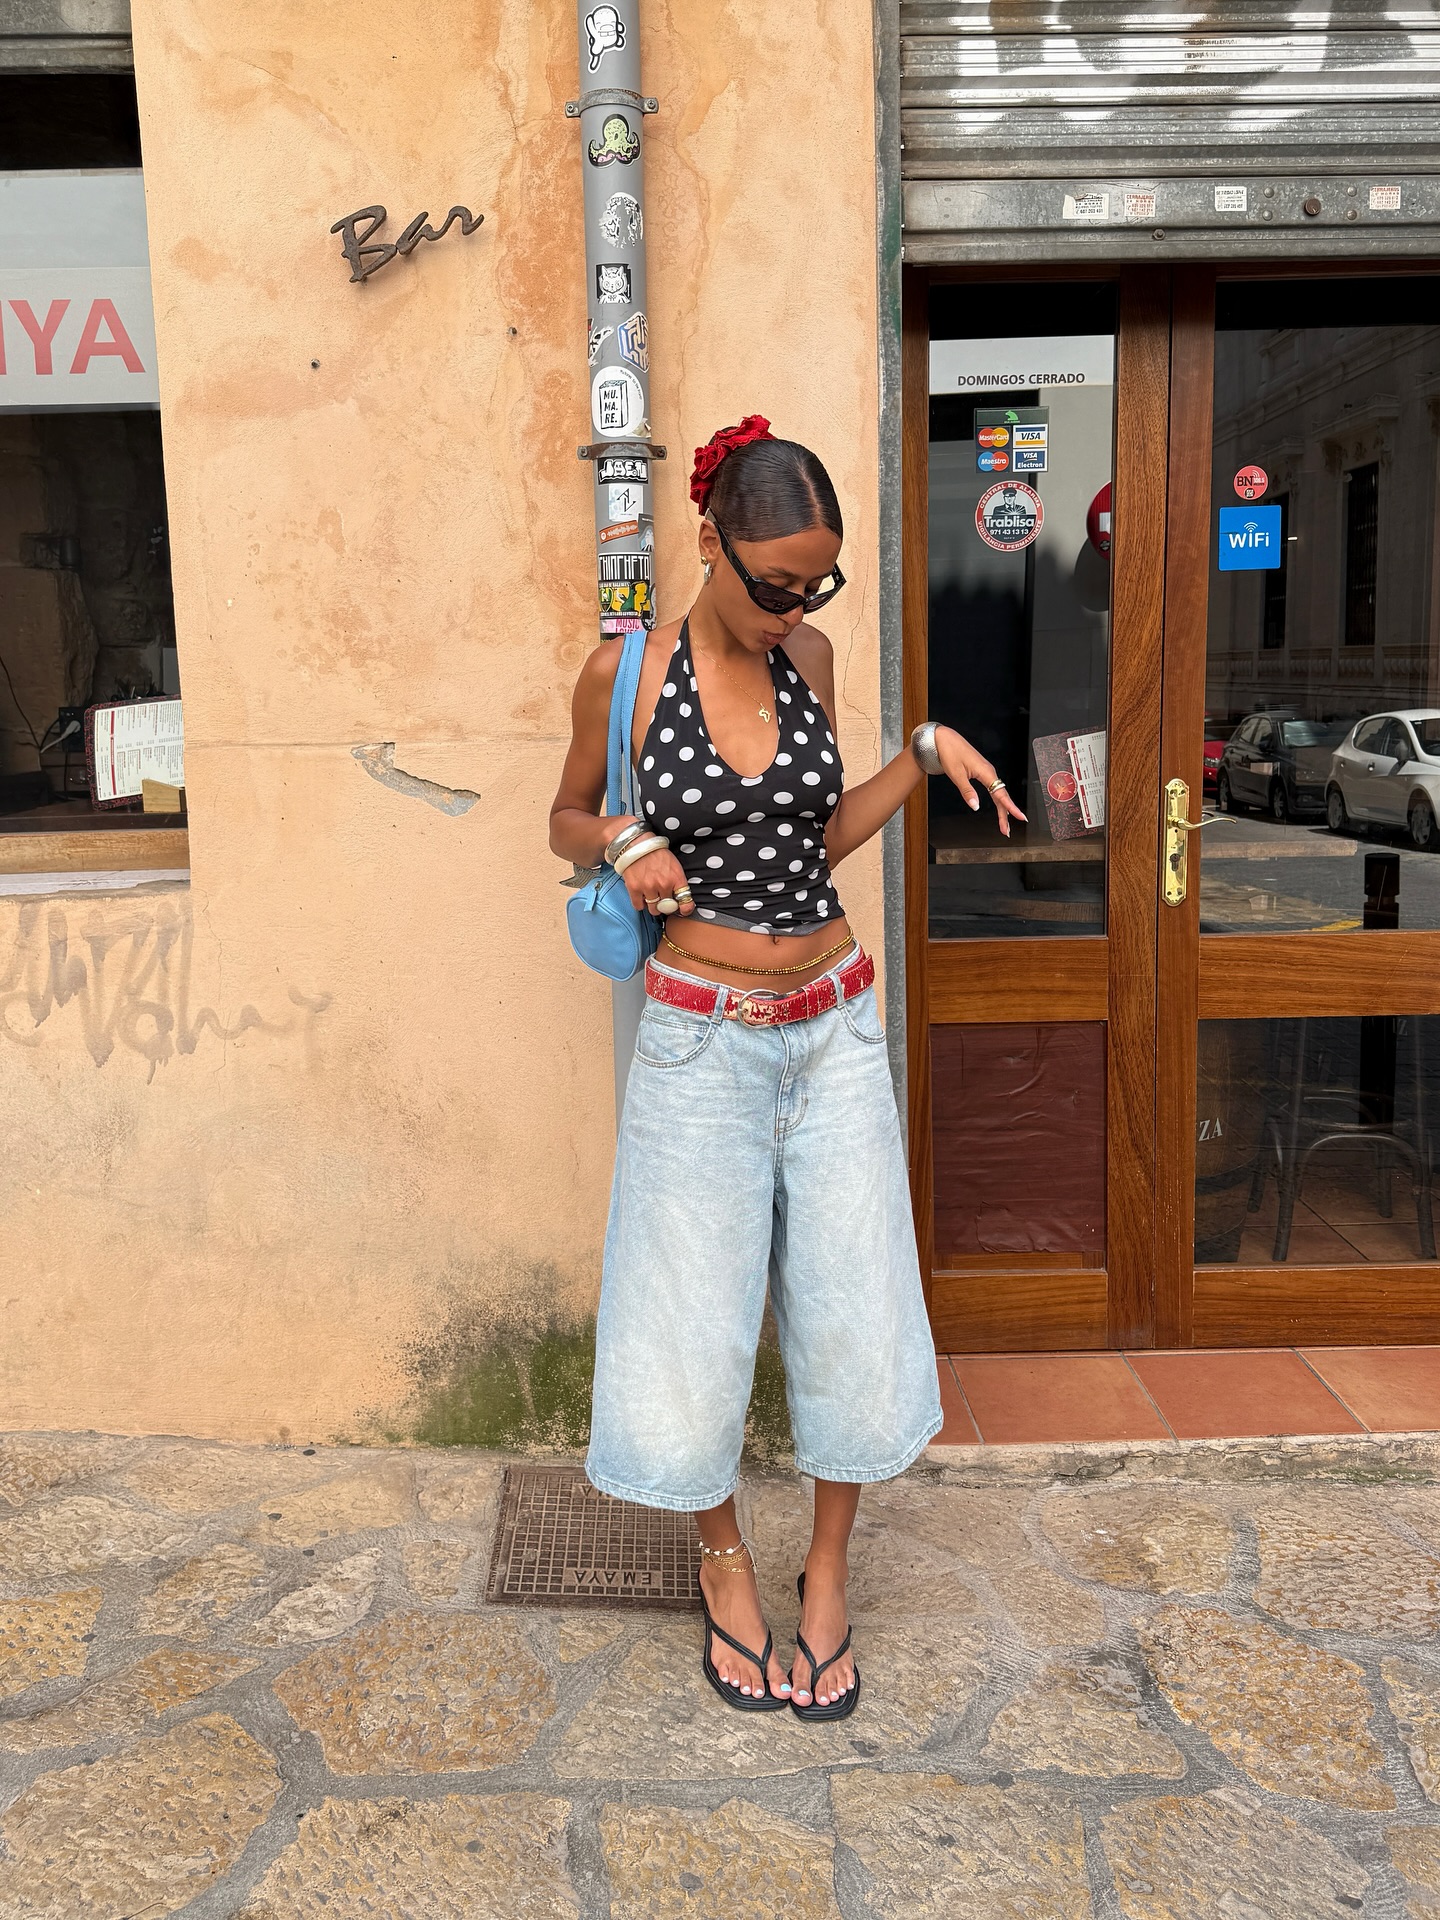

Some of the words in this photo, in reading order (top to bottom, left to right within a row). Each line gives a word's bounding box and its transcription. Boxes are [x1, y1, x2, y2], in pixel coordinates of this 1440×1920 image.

[330, 204, 485, 283] Bar
[0, 298, 146, 377] YA
[958, 374, 1025, 386] DOMINGOS
[1028, 373, 1085, 385] CERRADO
[1021, 432, 1041, 440] VISA
[1236, 475, 1254, 486] BN
[980, 484, 1006, 509] CENTRAL
[1019, 484, 1041, 508] ALARMA
[984, 515, 1035, 528] Trablisa
[978, 520, 1005, 549] VIGILANCIA
[1006, 520, 1042, 550] PERMANENTE
[616, 619, 640, 629] MUSIC
[574, 1570, 652, 1585] EMAYA
